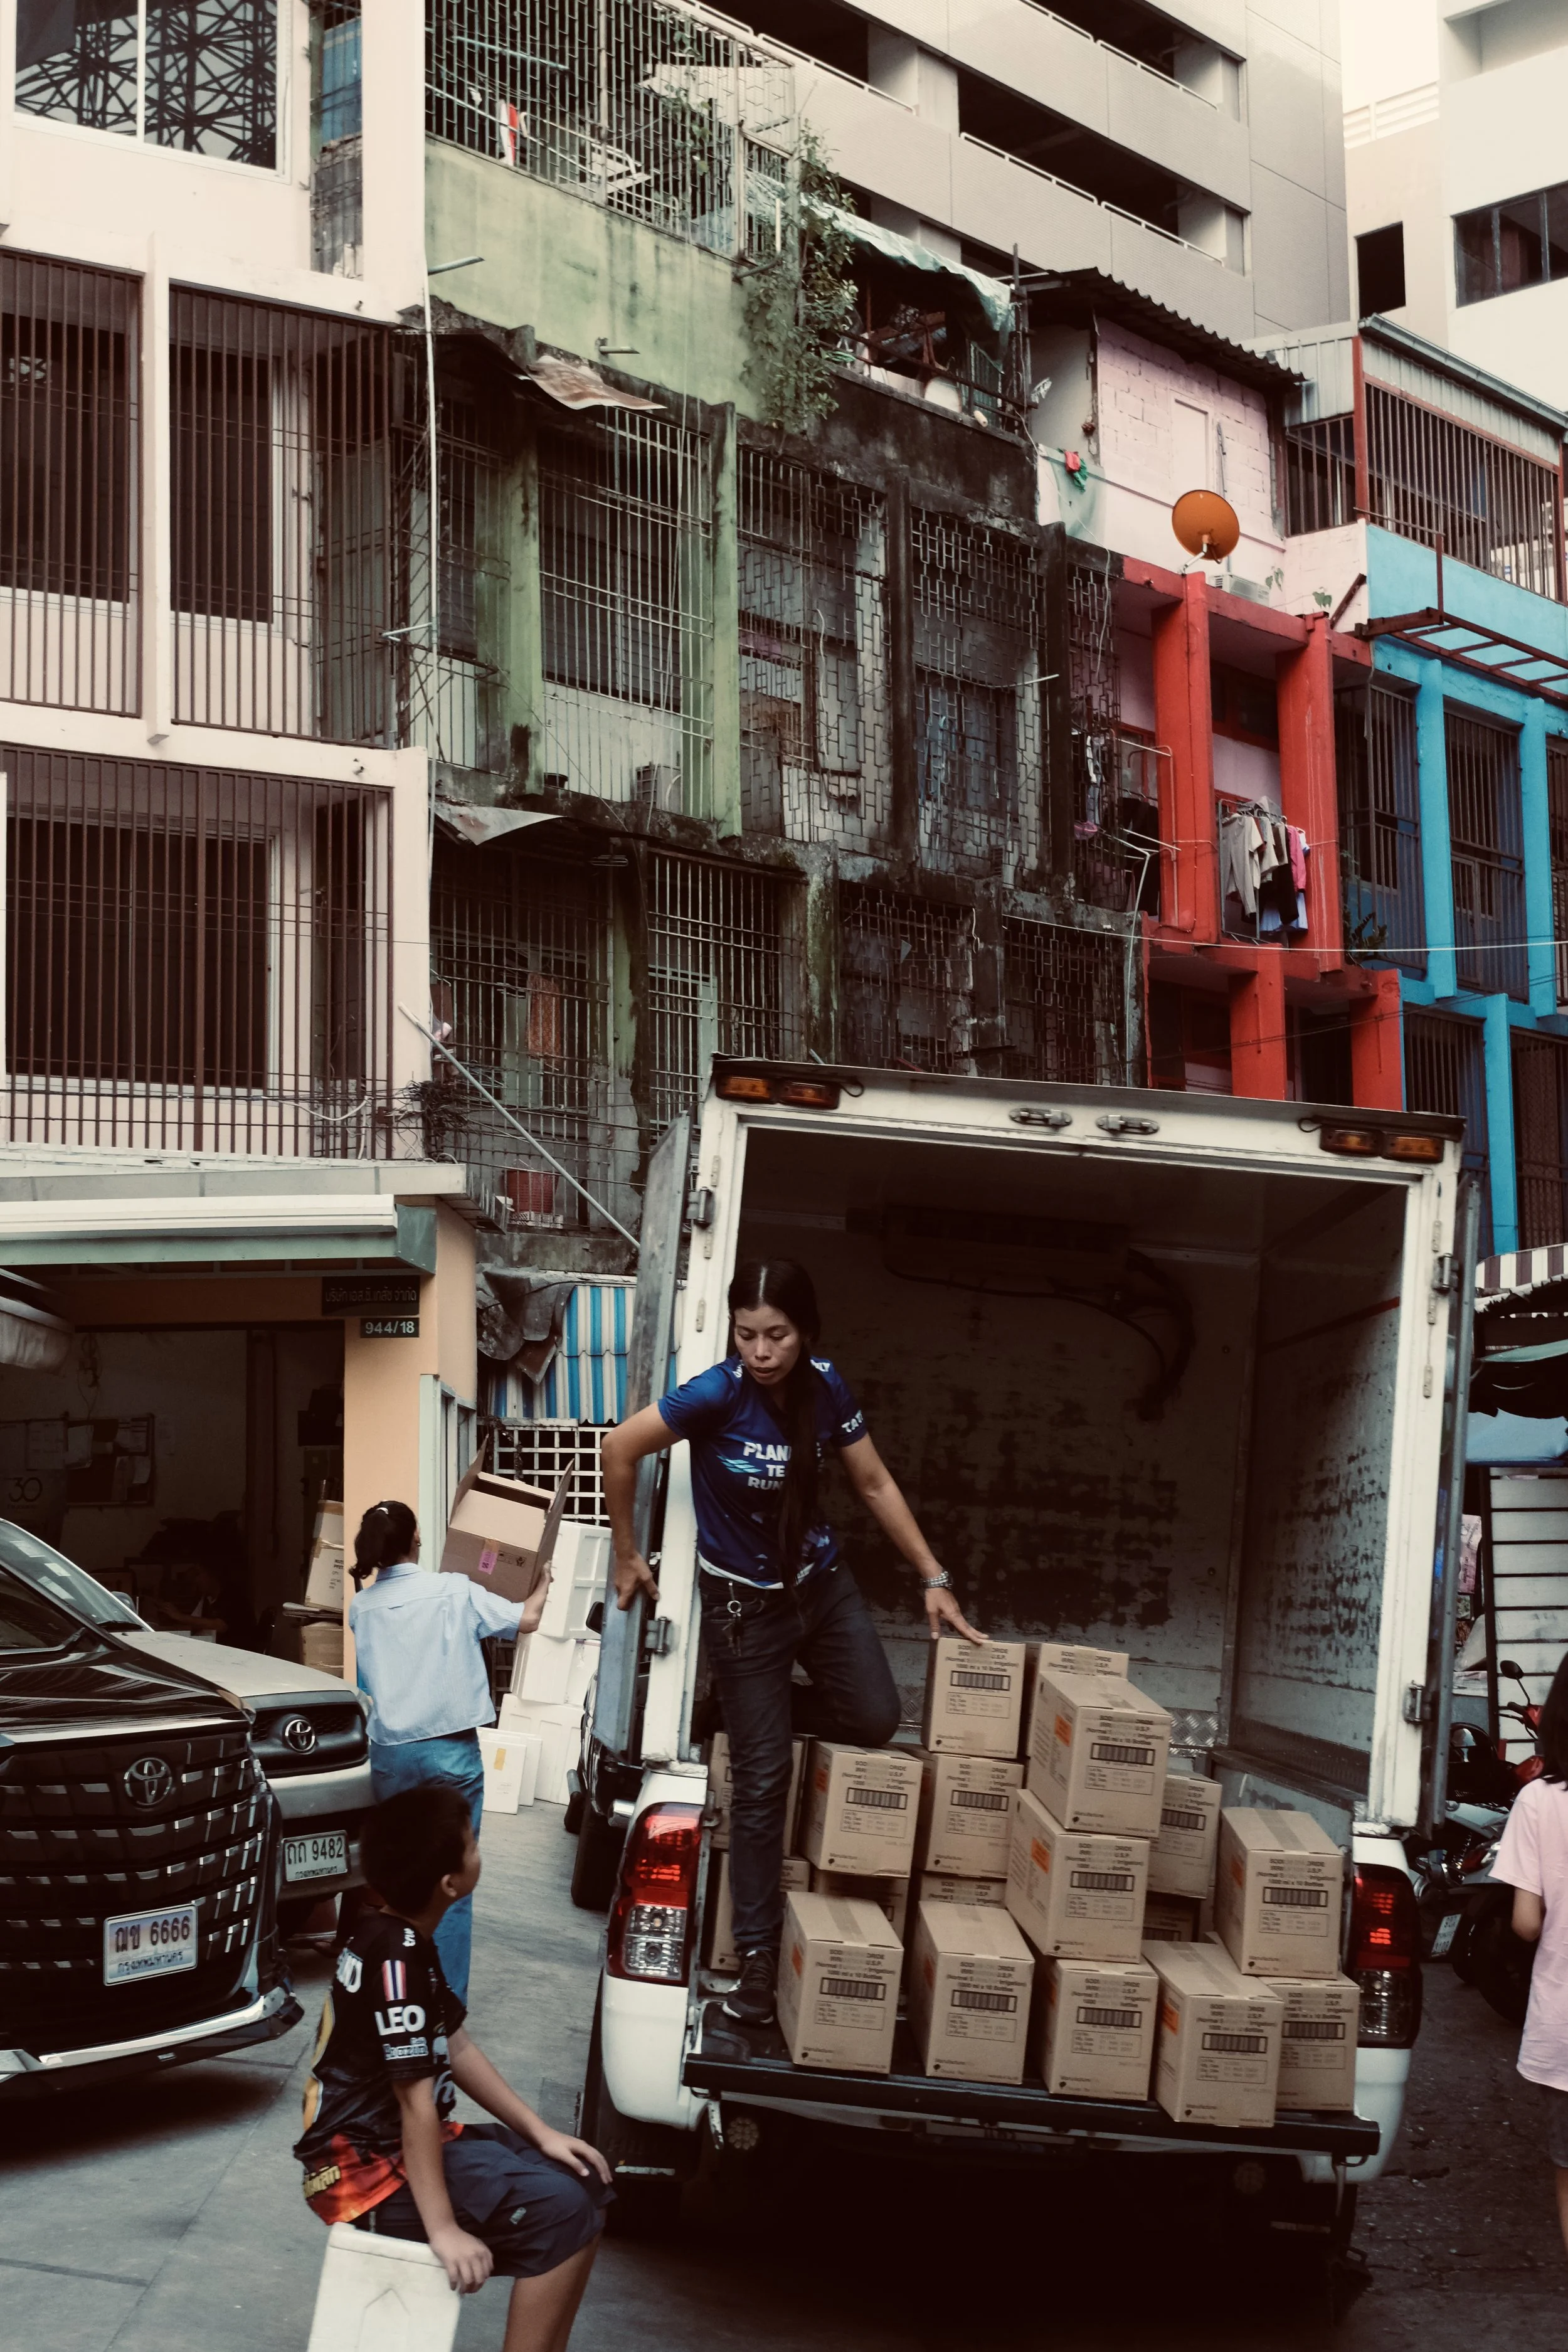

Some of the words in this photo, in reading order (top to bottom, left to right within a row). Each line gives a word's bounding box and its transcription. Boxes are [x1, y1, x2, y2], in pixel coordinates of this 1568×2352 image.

[365, 1320, 415, 1334] 944/18
[743, 1441, 792, 1461] PLAN
[766, 1464, 785, 1478] TE
[312, 1837, 342, 1860] 9482
[151, 1915, 190, 1946] 6666
[374, 2005, 426, 2036] LEO
